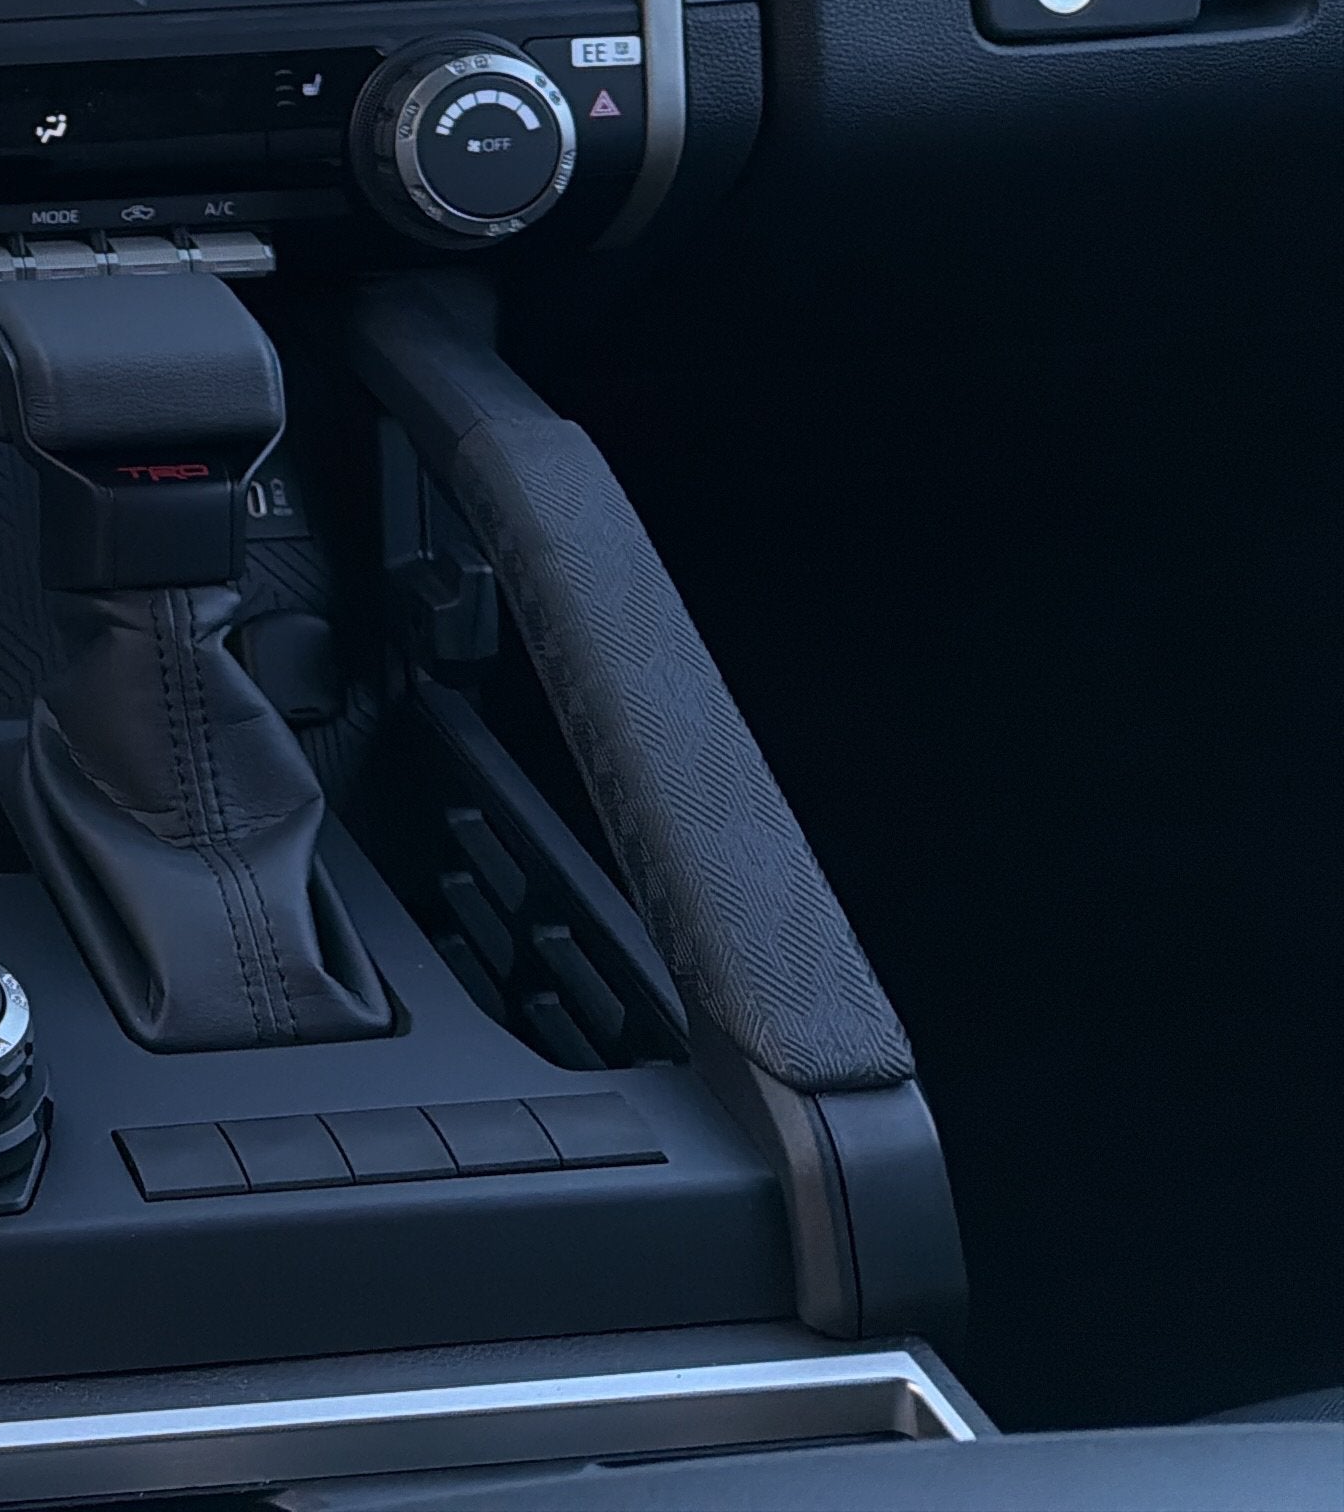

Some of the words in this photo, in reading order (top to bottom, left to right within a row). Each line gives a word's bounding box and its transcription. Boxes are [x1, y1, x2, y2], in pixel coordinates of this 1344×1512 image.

[582, 42, 608, 63] EE
[481, 137, 514, 153] OFF
[31, 208, 80, 226] MODE
[204, 201, 235, 218] A/C
[116, 464, 210, 481] TRD
